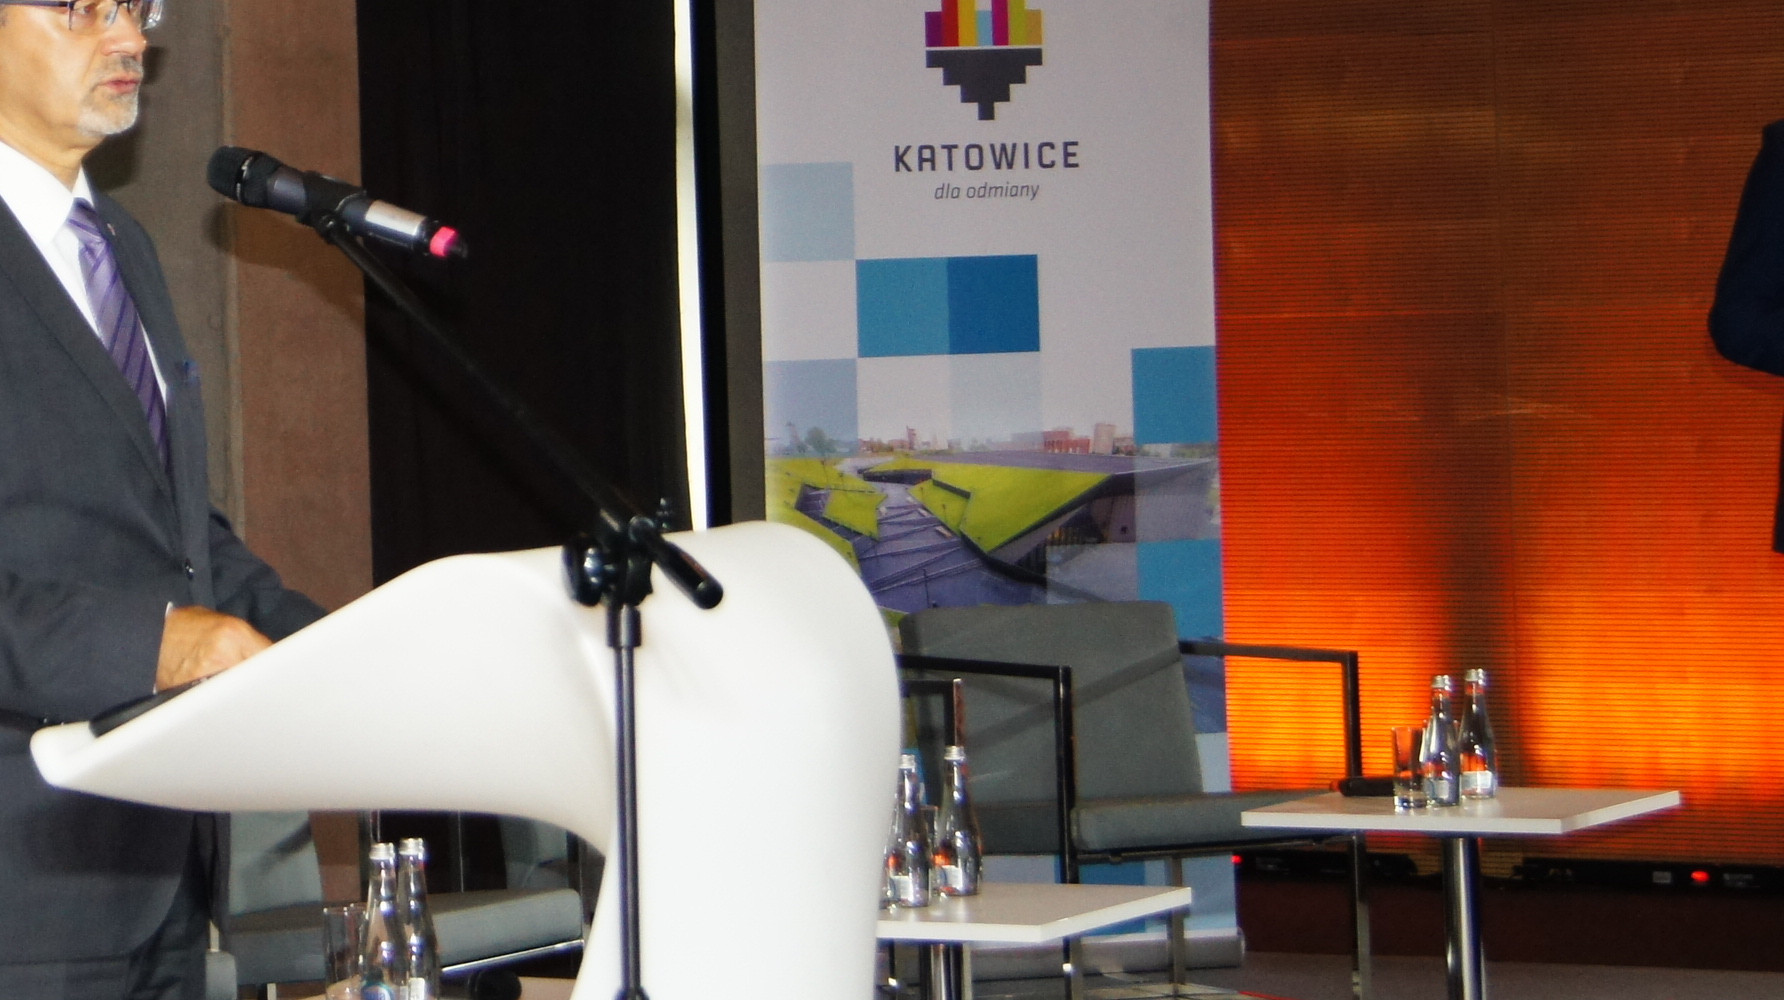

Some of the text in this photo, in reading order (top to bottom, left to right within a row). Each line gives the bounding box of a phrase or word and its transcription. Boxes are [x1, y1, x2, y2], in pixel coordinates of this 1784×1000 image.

[894, 140, 1080, 172] KATOWICE
[934, 181, 1040, 201] dla odmiany
